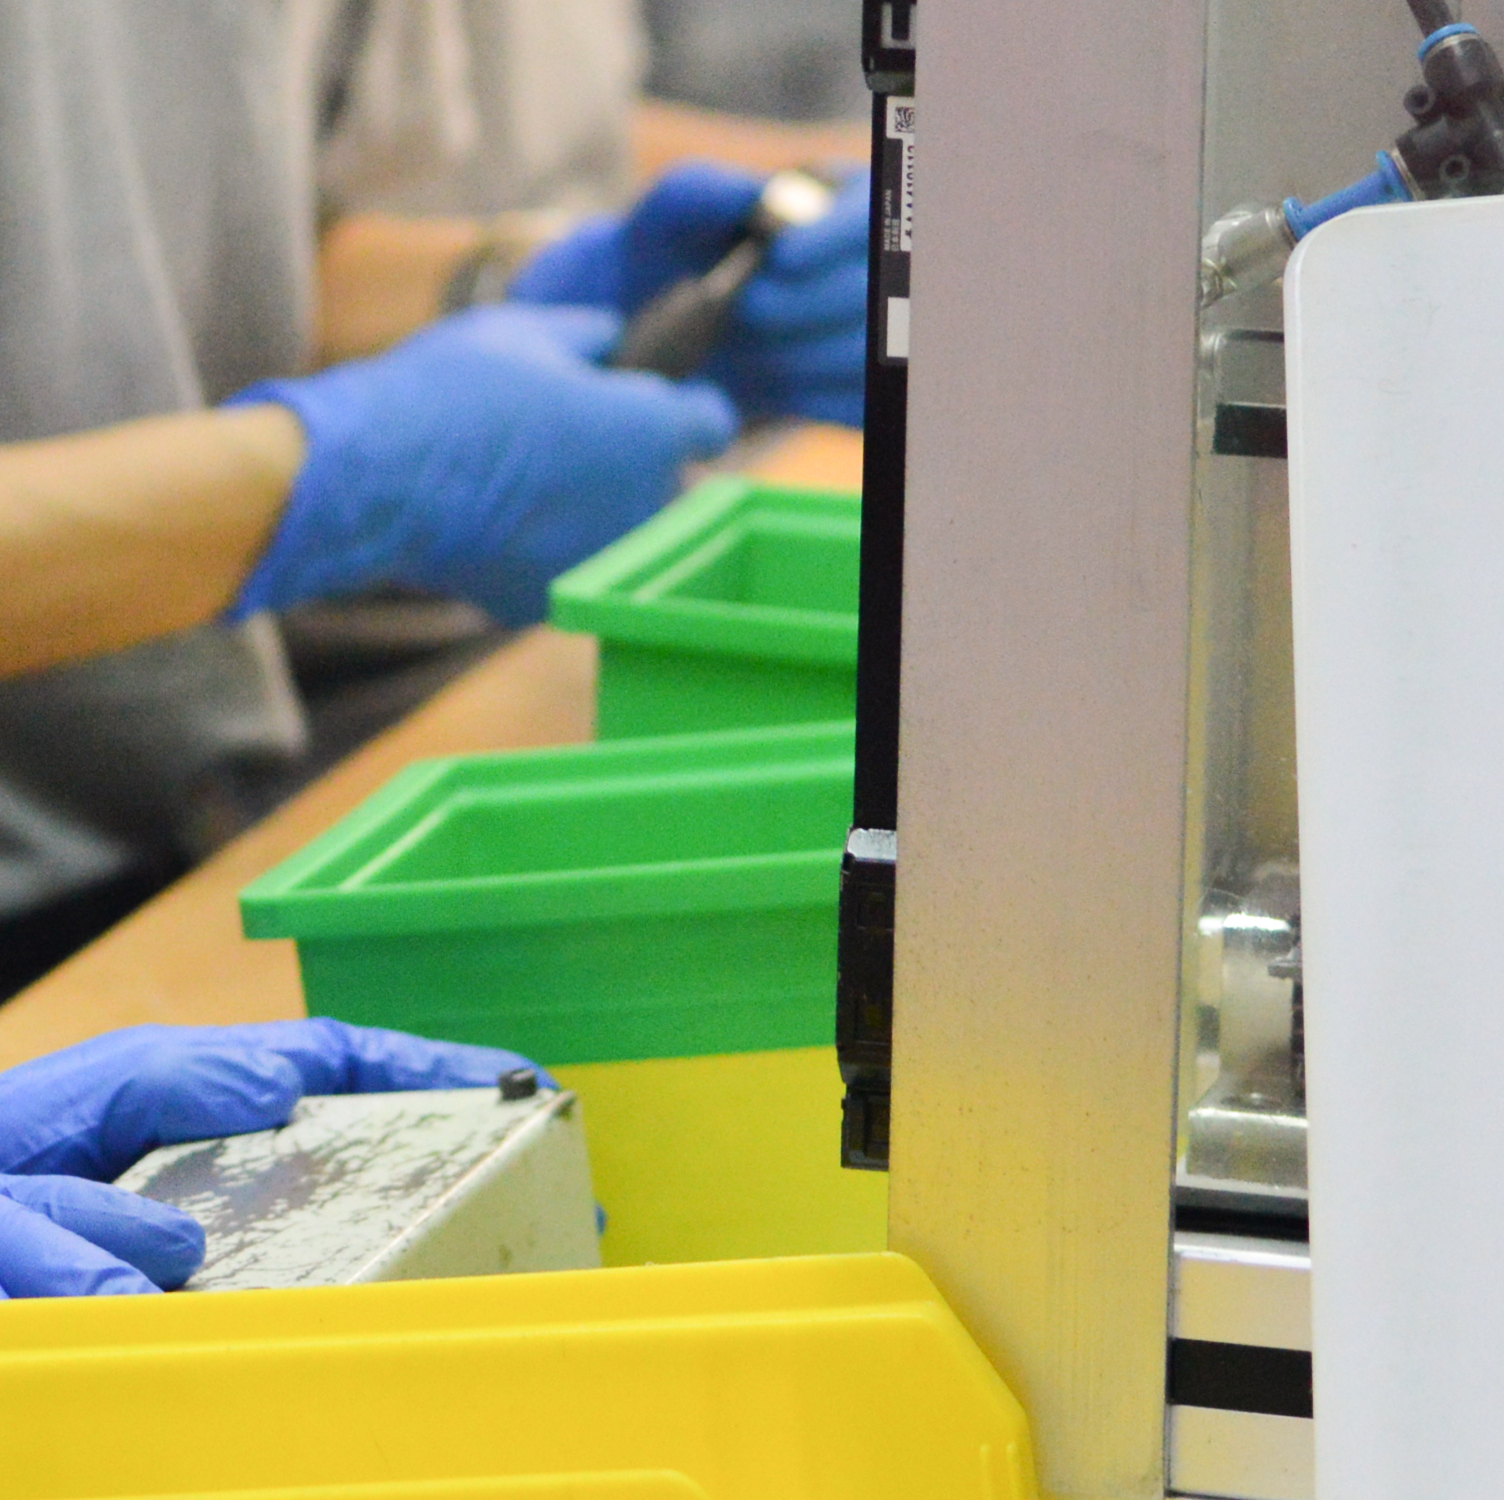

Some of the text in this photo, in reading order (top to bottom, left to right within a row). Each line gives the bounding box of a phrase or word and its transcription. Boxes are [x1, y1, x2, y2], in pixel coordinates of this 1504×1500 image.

[883, 189, 892, 251] MADE IN JAPAN
